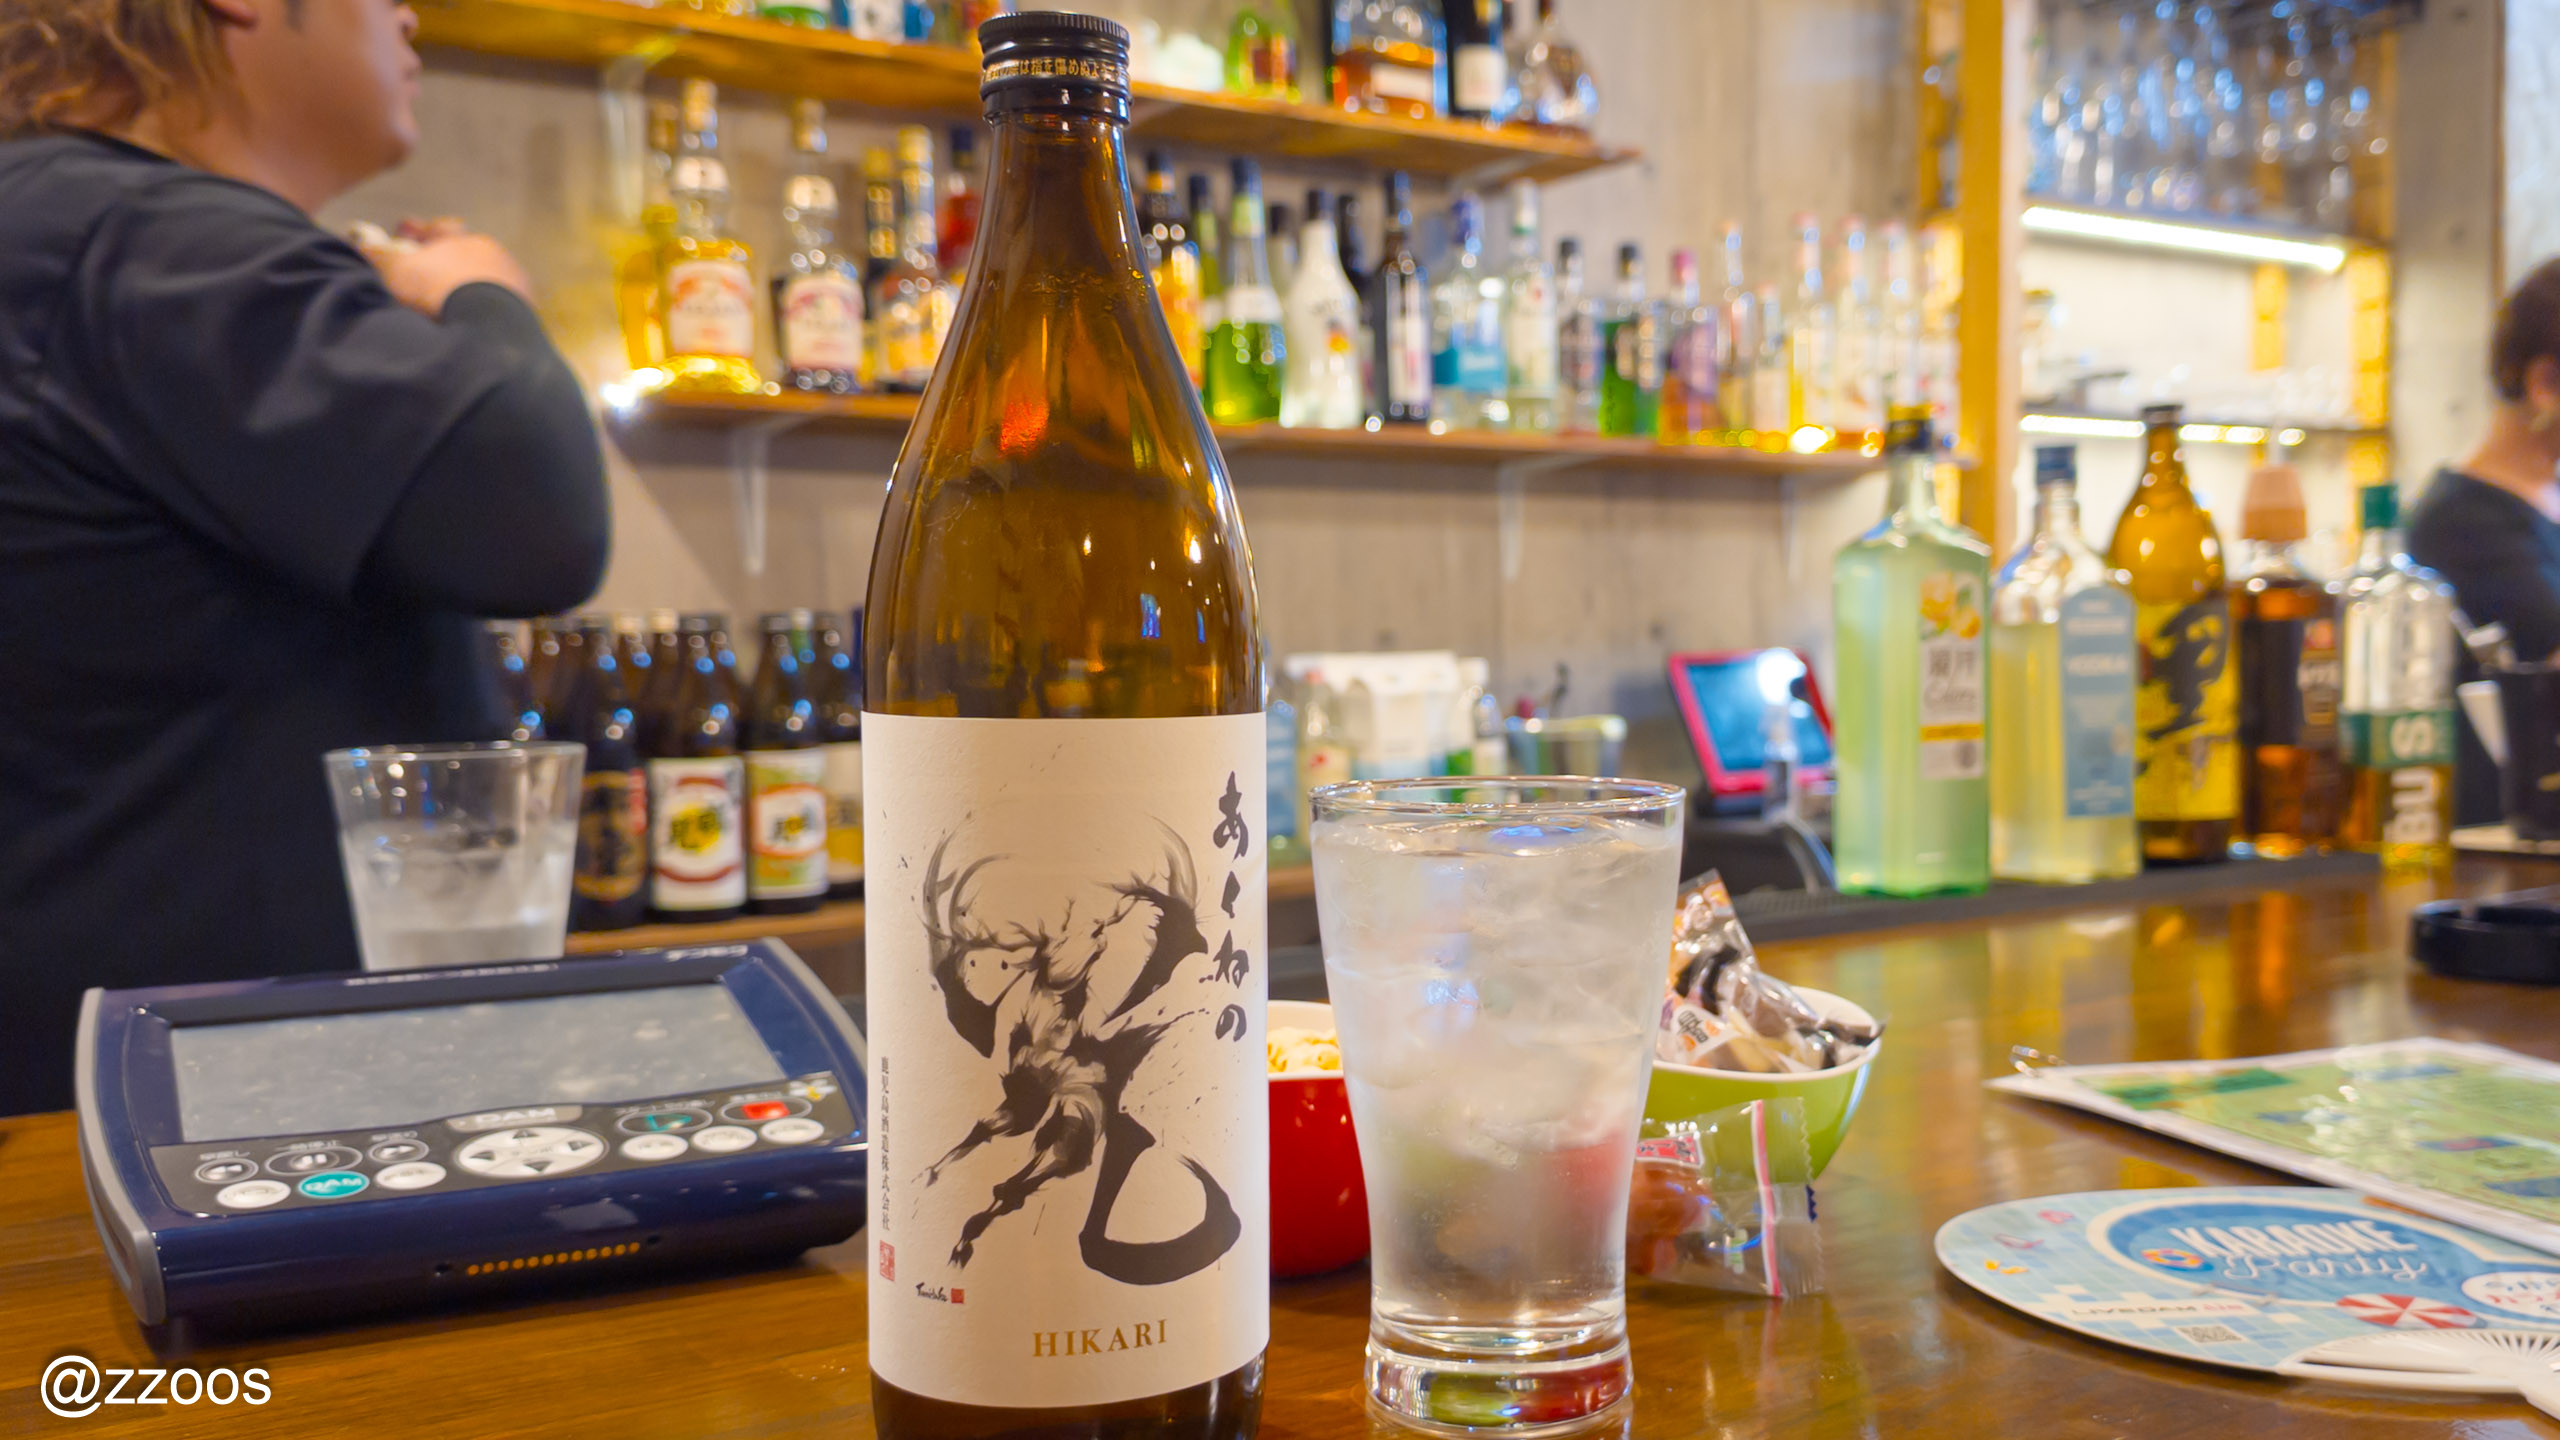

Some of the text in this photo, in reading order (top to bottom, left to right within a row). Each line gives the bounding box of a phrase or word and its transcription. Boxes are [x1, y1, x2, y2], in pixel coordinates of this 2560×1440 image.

[2169, 1219, 2419, 1258] KARAOKE
[2223, 1253, 2428, 1282] Party
[1032, 1318, 1168, 1358] HIKARI
